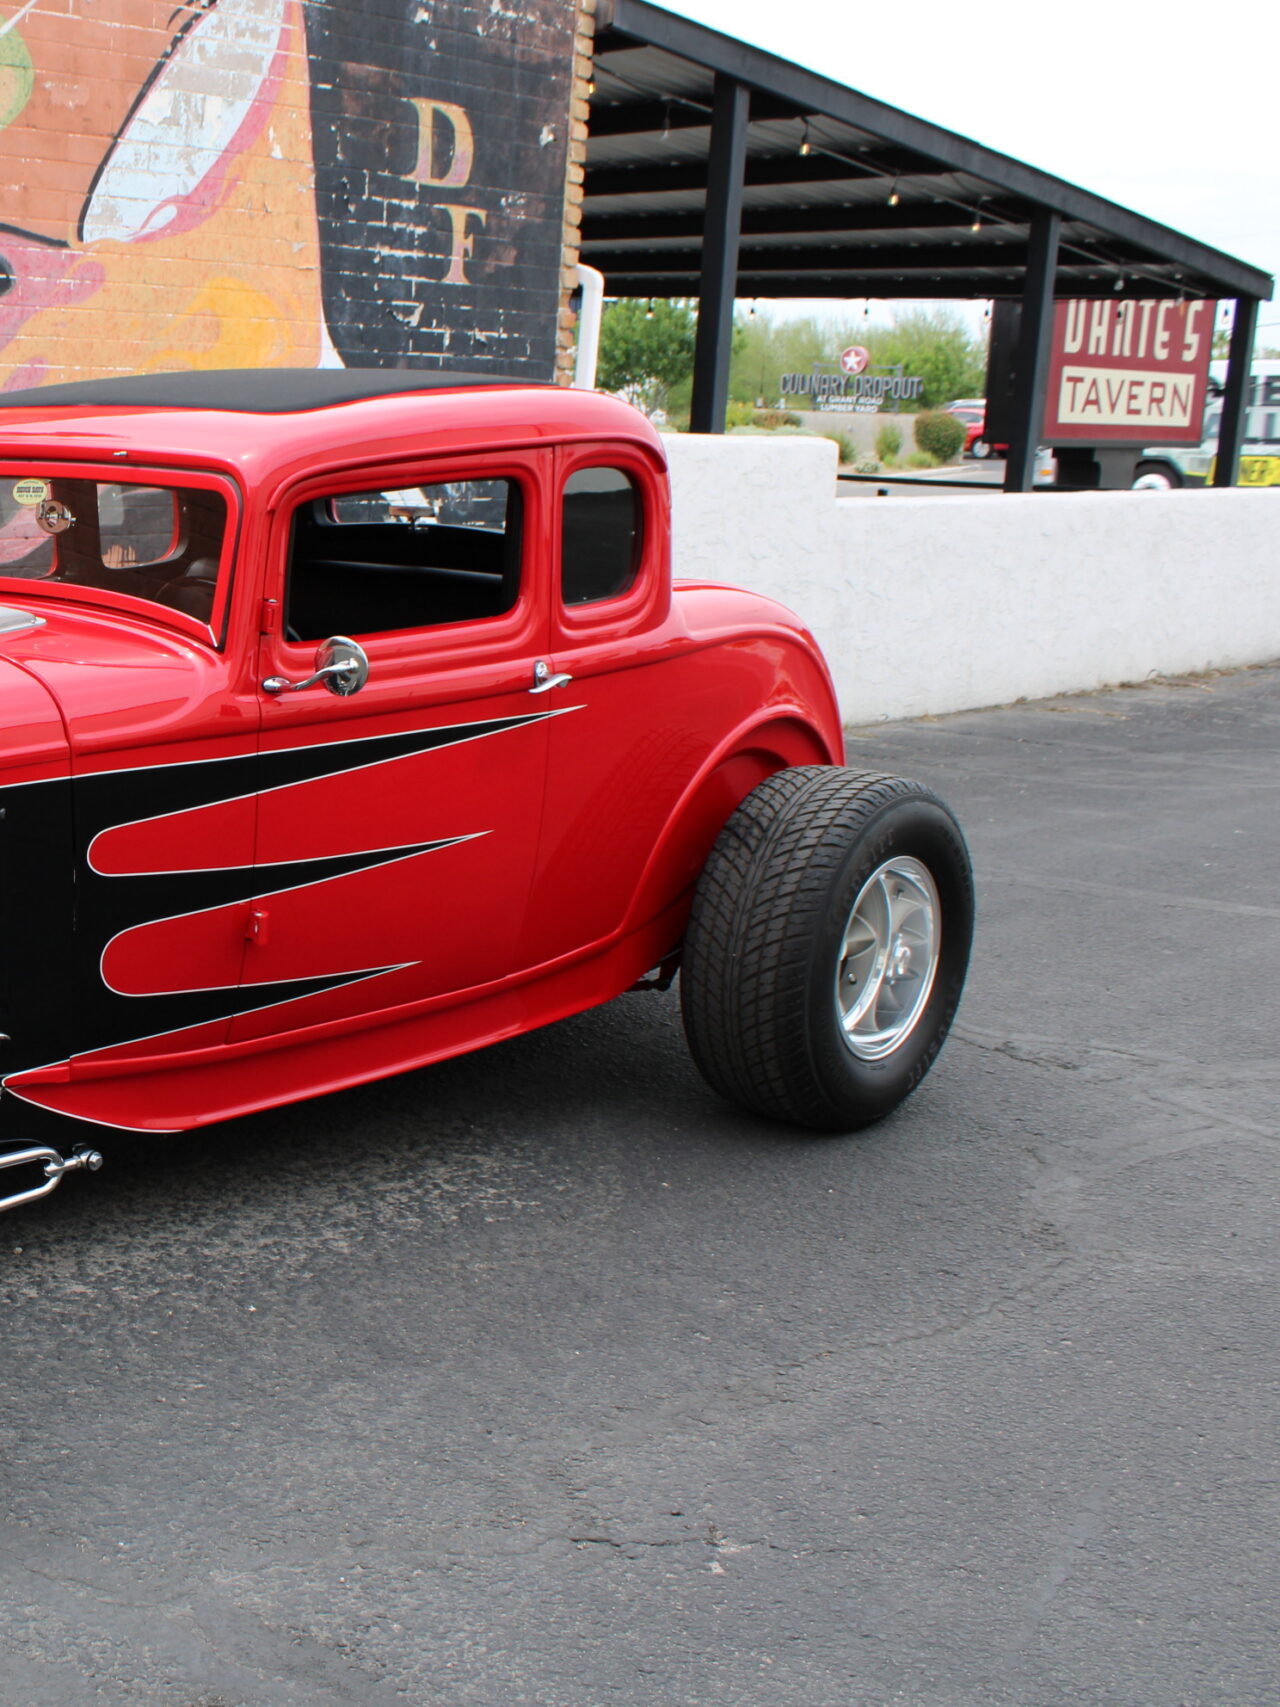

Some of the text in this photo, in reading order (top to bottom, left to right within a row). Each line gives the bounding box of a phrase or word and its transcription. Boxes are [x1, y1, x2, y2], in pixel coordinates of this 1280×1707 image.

[400, 97, 475, 189] D
[433, 204, 489, 286] F
[1063, 299, 1205, 362] DANTES
[780, 373, 923, 399] CULINARY DROPOUT
[1065, 376, 1191, 418] TAVERN
